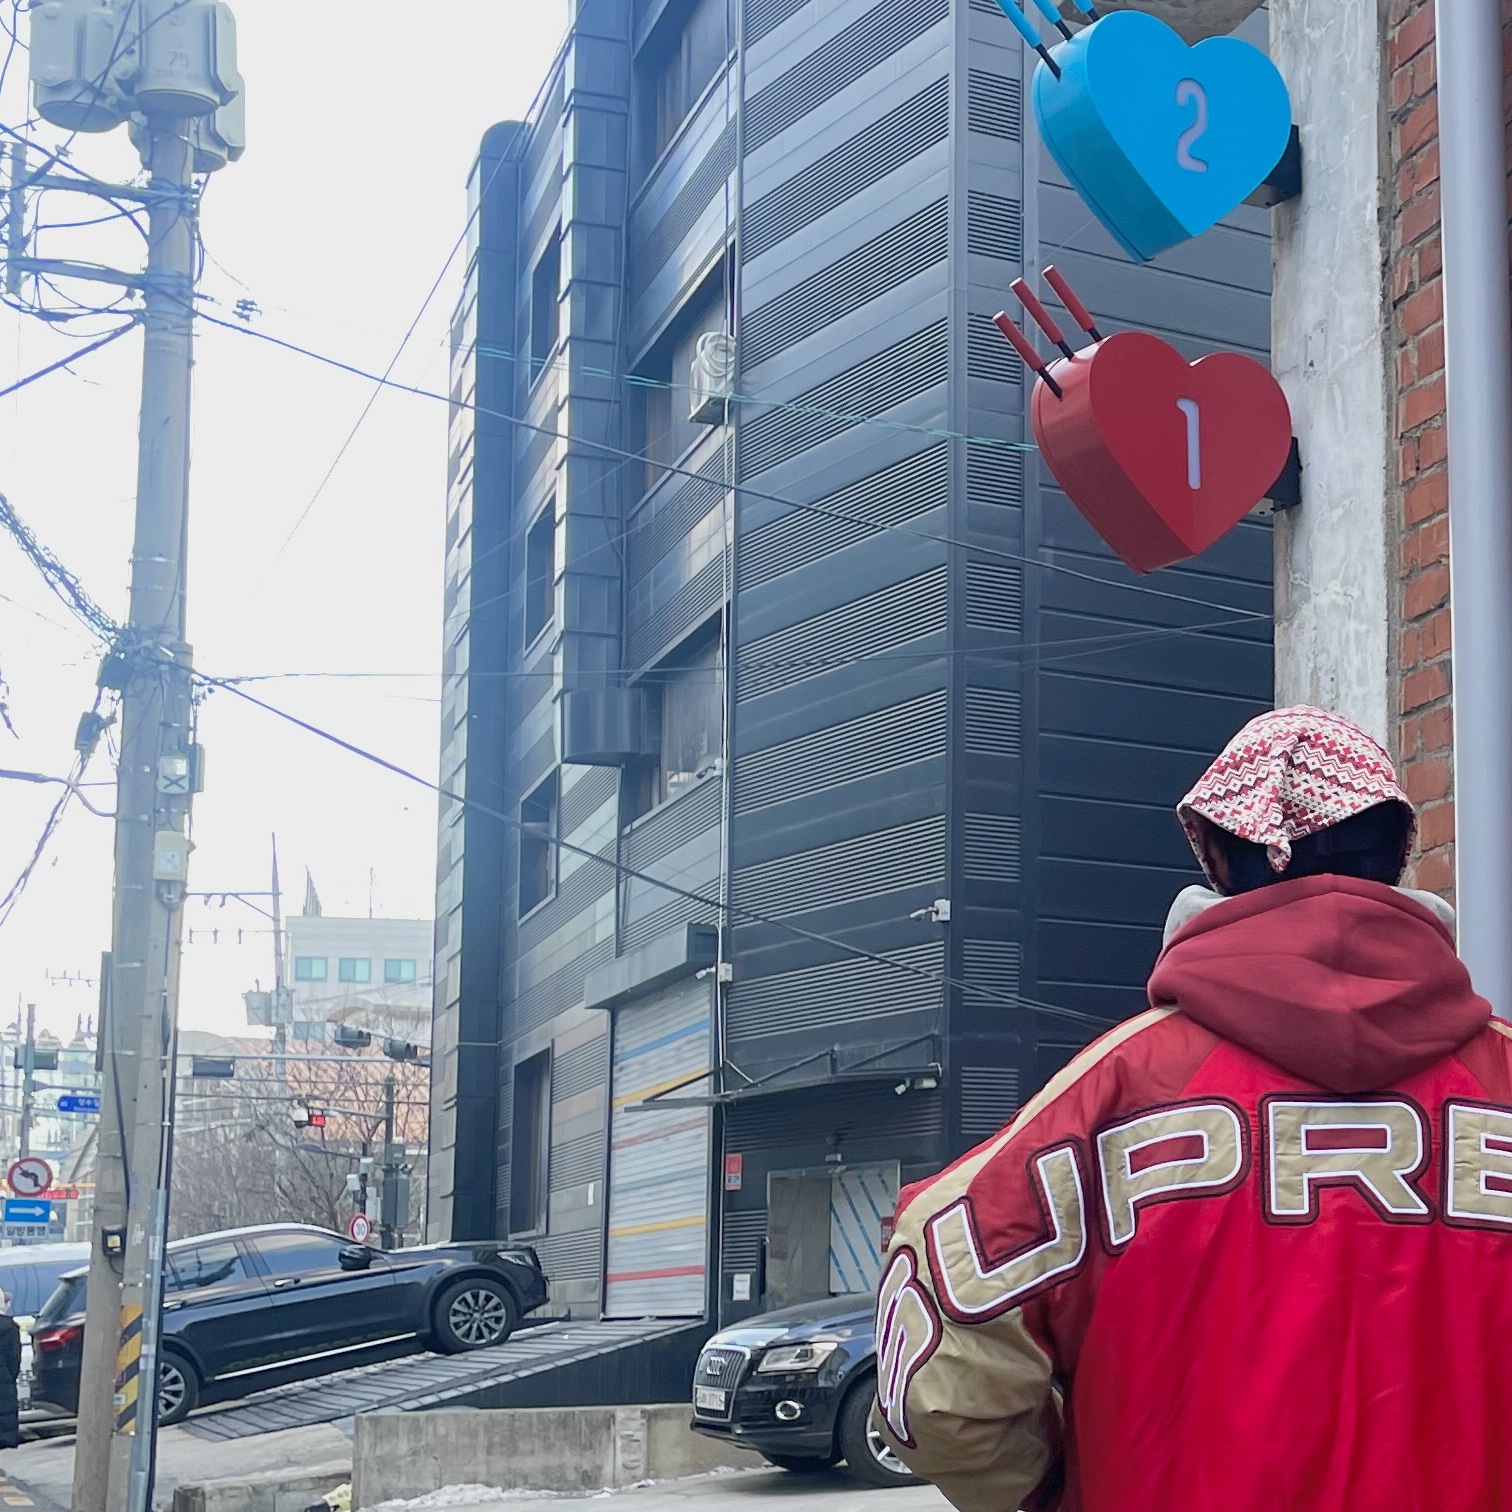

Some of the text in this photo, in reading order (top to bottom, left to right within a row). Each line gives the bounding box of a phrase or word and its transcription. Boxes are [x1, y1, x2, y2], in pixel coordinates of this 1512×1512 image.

[1176, 78, 1209, 173] 2
[1176, 397, 1201, 490] 1
[356, 1223, 366, 1236] 30
